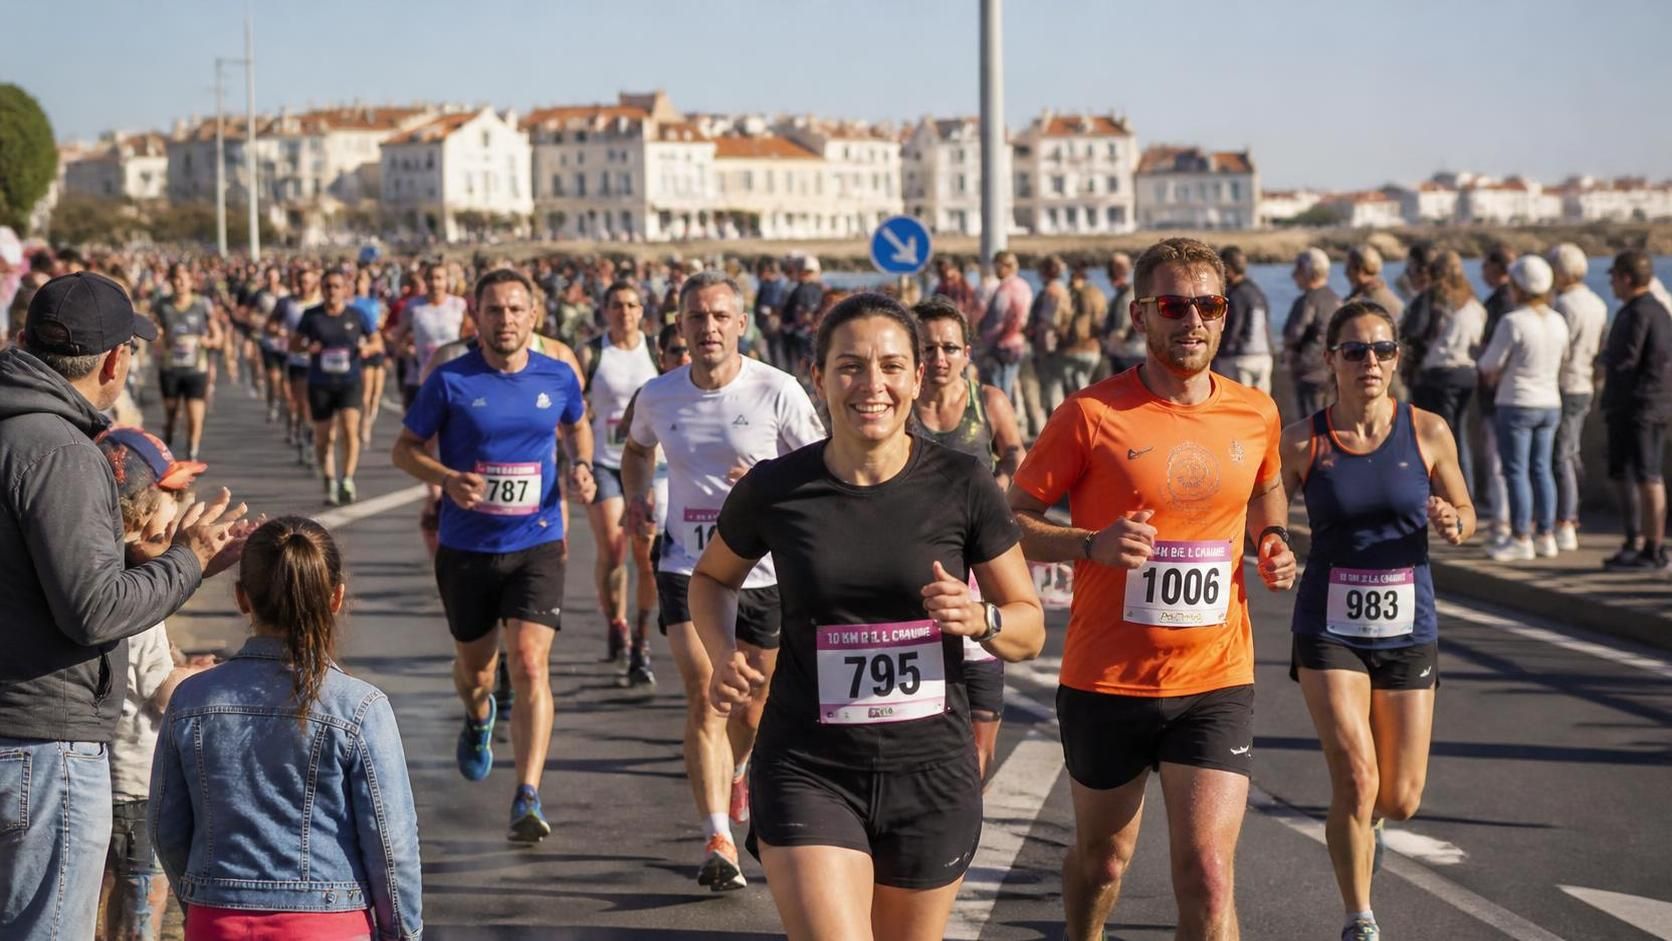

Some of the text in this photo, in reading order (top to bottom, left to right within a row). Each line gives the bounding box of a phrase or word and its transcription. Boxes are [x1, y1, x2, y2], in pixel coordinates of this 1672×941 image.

[488, 479, 529, 503] 787
[1142, 566, 1220, 606] 1006
[1345, 589, 1399, 621] 983
[844, 651, 921, 699] 795
